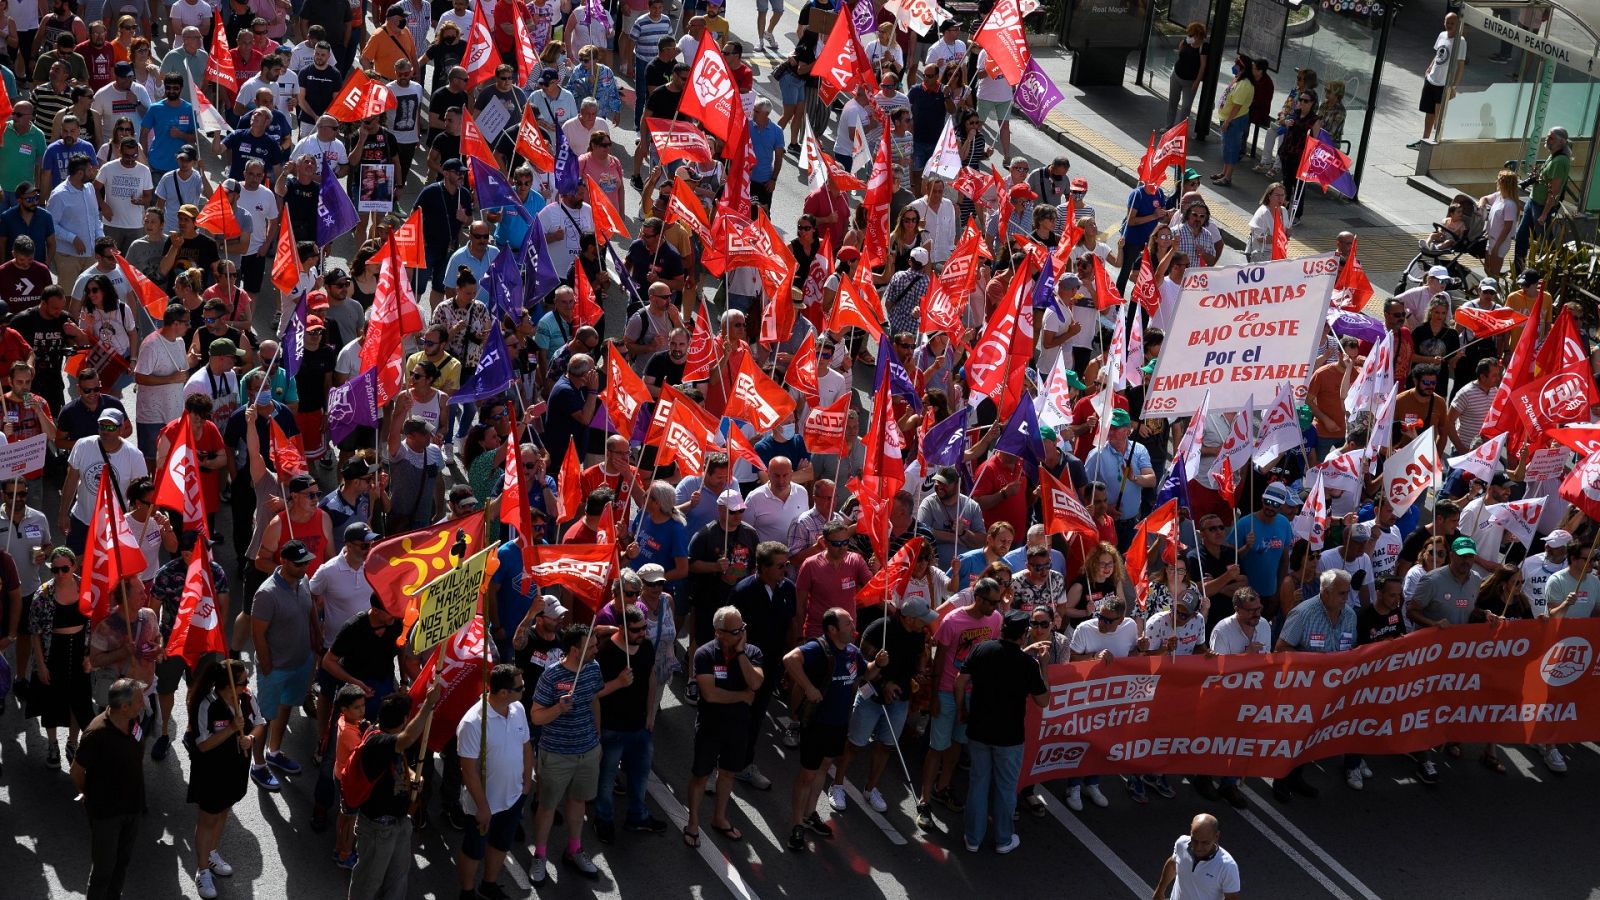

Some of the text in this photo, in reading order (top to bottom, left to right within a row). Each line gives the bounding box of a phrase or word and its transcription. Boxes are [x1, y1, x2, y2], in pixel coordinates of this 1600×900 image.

[1484, 18, 1570, 62] ENTRADA PEATONAL
[700, 57, 729, 91] UGT
[1237, 267, 1265, 285] NO
[1302, 258, 1338, 275] USO
[1183, 273, 1210, 289] USO
[9, 294, 41, 304] CONVERSE
[1199, 283, 1307, 309] CONTRATAS
[1233, 310, 1260, 322] de
[1187, 319, 1300, 347] BAJO COSTE
[1242, 345, 1262, 363] el
[1152, 363, 1310, 392] EMPLEO ESTABLE
[1144, 396, 1178, 411] USO
[1373, 560, 1383, 568] DE
[434, 571, 483, 612] MARCANO
[1531, 576, 1548, 584] HAZ
[420, 610, 443, 634] NOS
[424, 607, 472, 649] PELANDO
[1202, 638, 1530, 689] POR UN CONVENIO DIGNO
[1548, 645, 1589, 665] UGT
[1049, 682, 1128, 711] CCOO
[1237, 672, 1481, 724] PARA LA INDUSTRIA
[1039, 704, 1150, 741] industria
[1399, 708, 1431, 732] DE
[1435, 702, 1578, 725] CANTABRIA
[1035, 746, 1085, 766] USO
